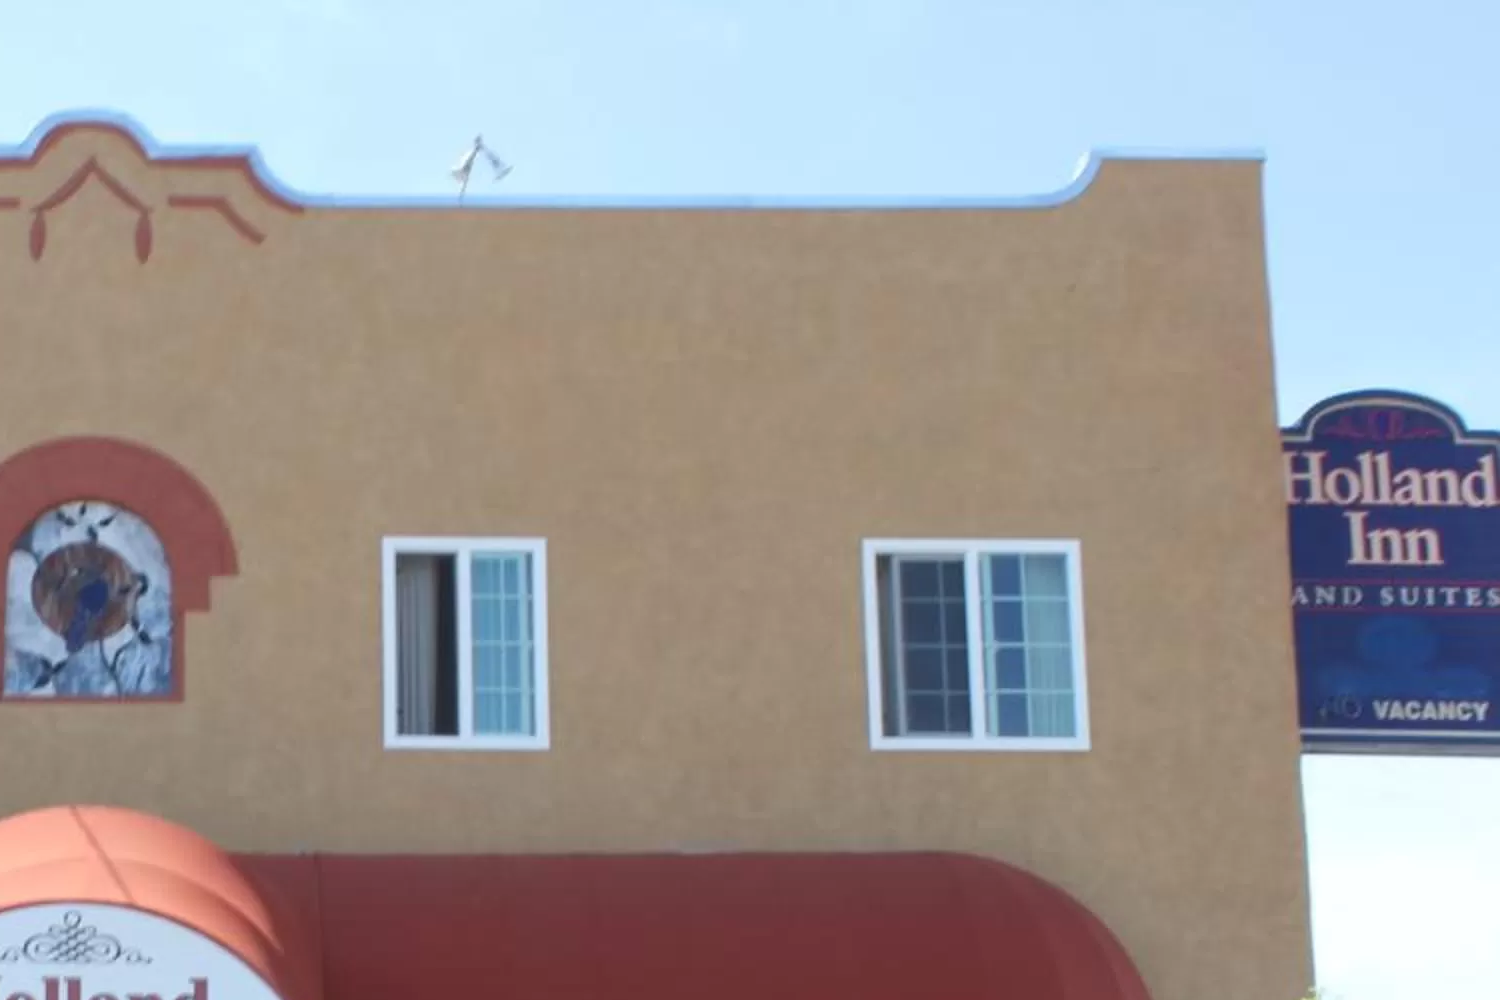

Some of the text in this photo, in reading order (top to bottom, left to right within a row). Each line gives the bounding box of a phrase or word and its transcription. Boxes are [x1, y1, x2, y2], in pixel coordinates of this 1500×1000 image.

[1283, 449, 1500, 508] Holland
[1343, 511, 1444, 566] Inn
[1291, 585, 1500, 608] AND SUITES
[1372, 699, 1490, 722] VACANCY
